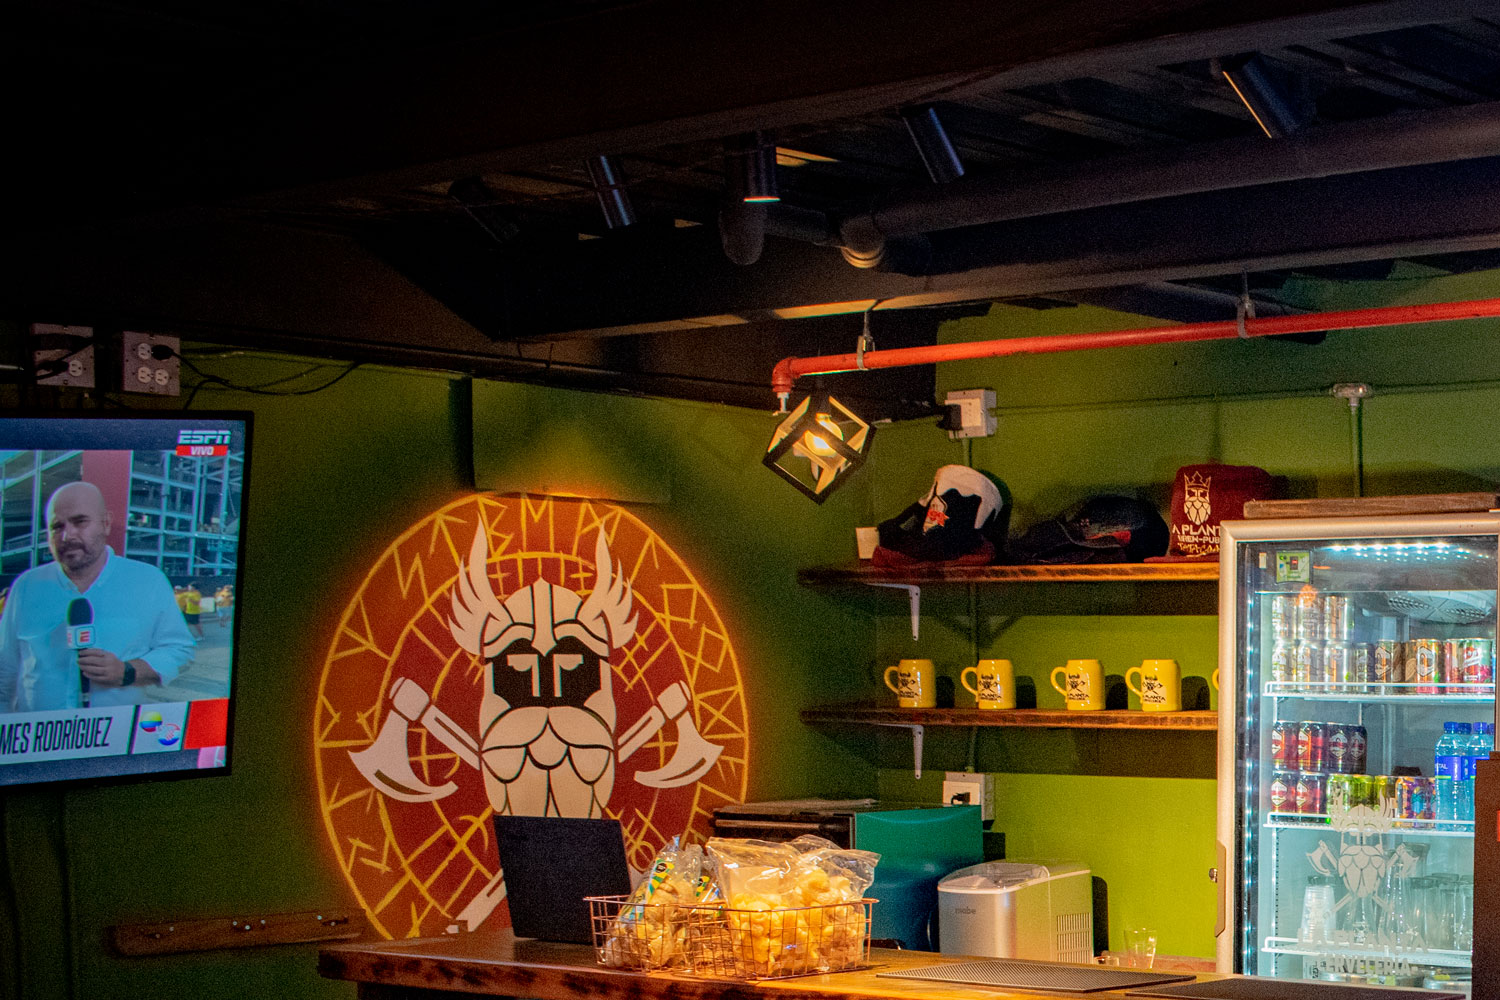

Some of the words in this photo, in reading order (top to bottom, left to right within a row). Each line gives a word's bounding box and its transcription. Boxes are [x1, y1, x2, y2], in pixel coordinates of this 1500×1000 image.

[177, 430, 231, 445] ESPN
[191, 446, 214, 456] VIVO
[1181, 525, 1220, 537] PLANT
[0, 722, 31, 755] MES
[32, 714, 114, 753] RODRÍGUEZ
